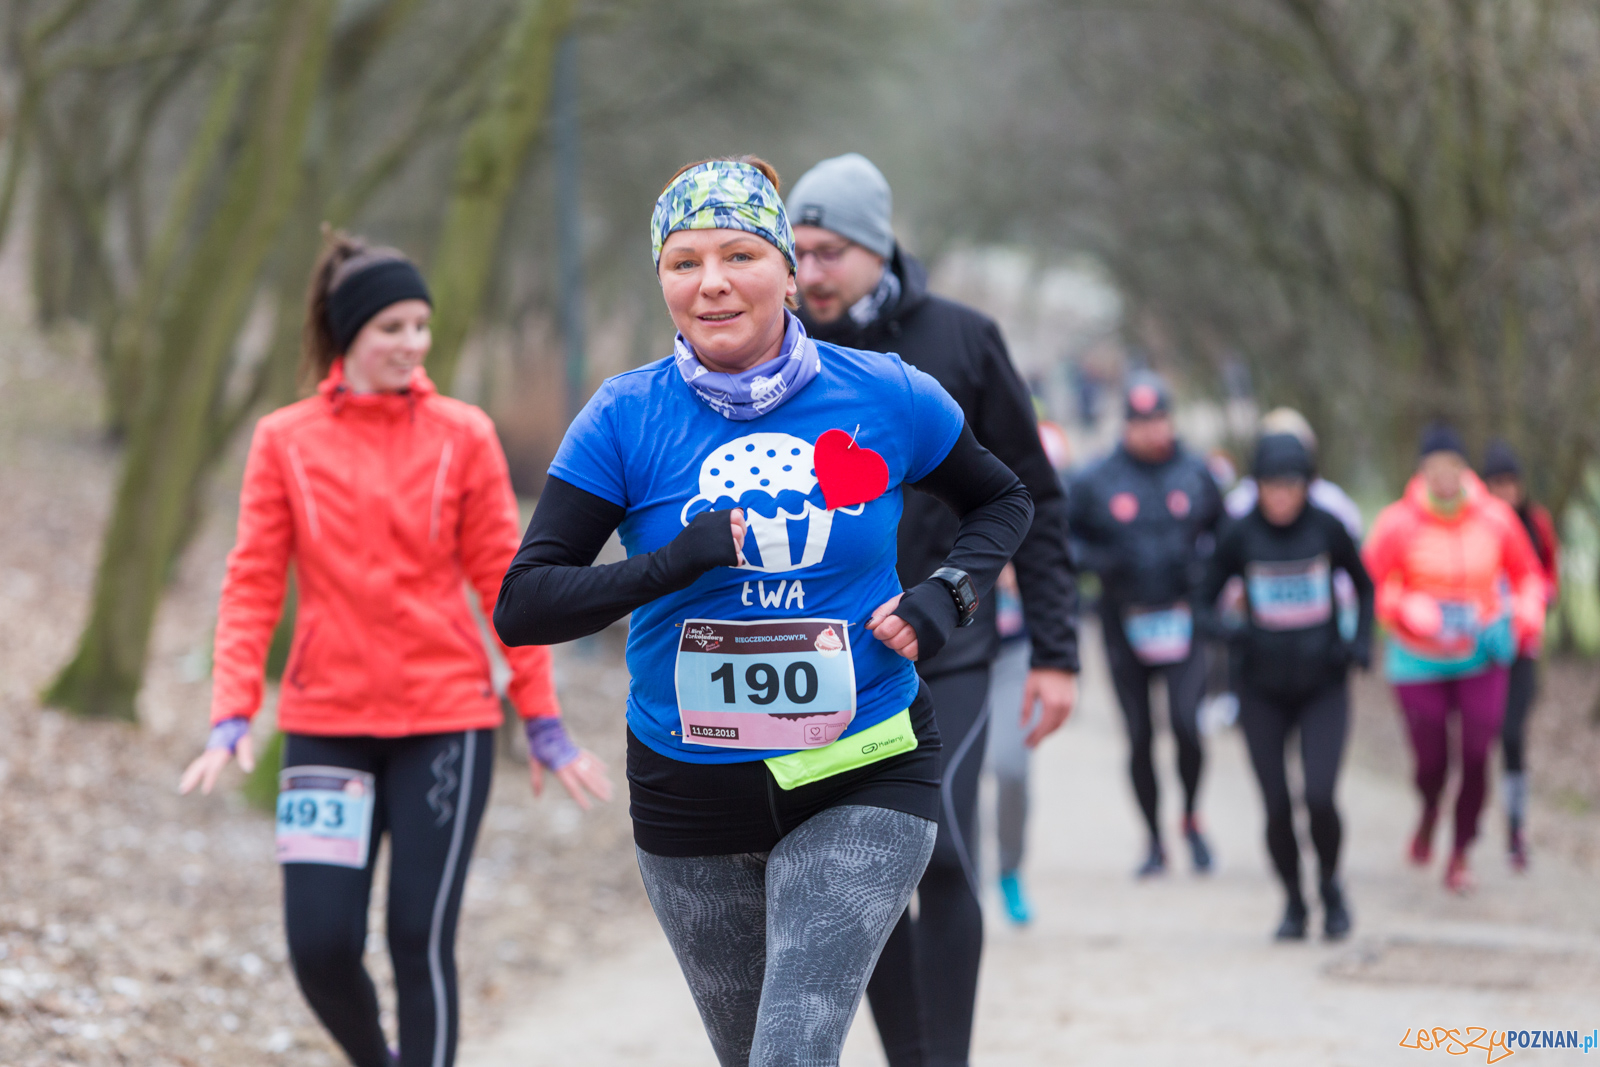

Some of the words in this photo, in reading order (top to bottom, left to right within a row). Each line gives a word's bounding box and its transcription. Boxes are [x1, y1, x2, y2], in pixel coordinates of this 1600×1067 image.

[735, 634, 808, 643] BIEGCZEKOLADOWY.PL
[710, 661, 818, 705] 190
[692, 727, 736, 737] 11.02.2018
